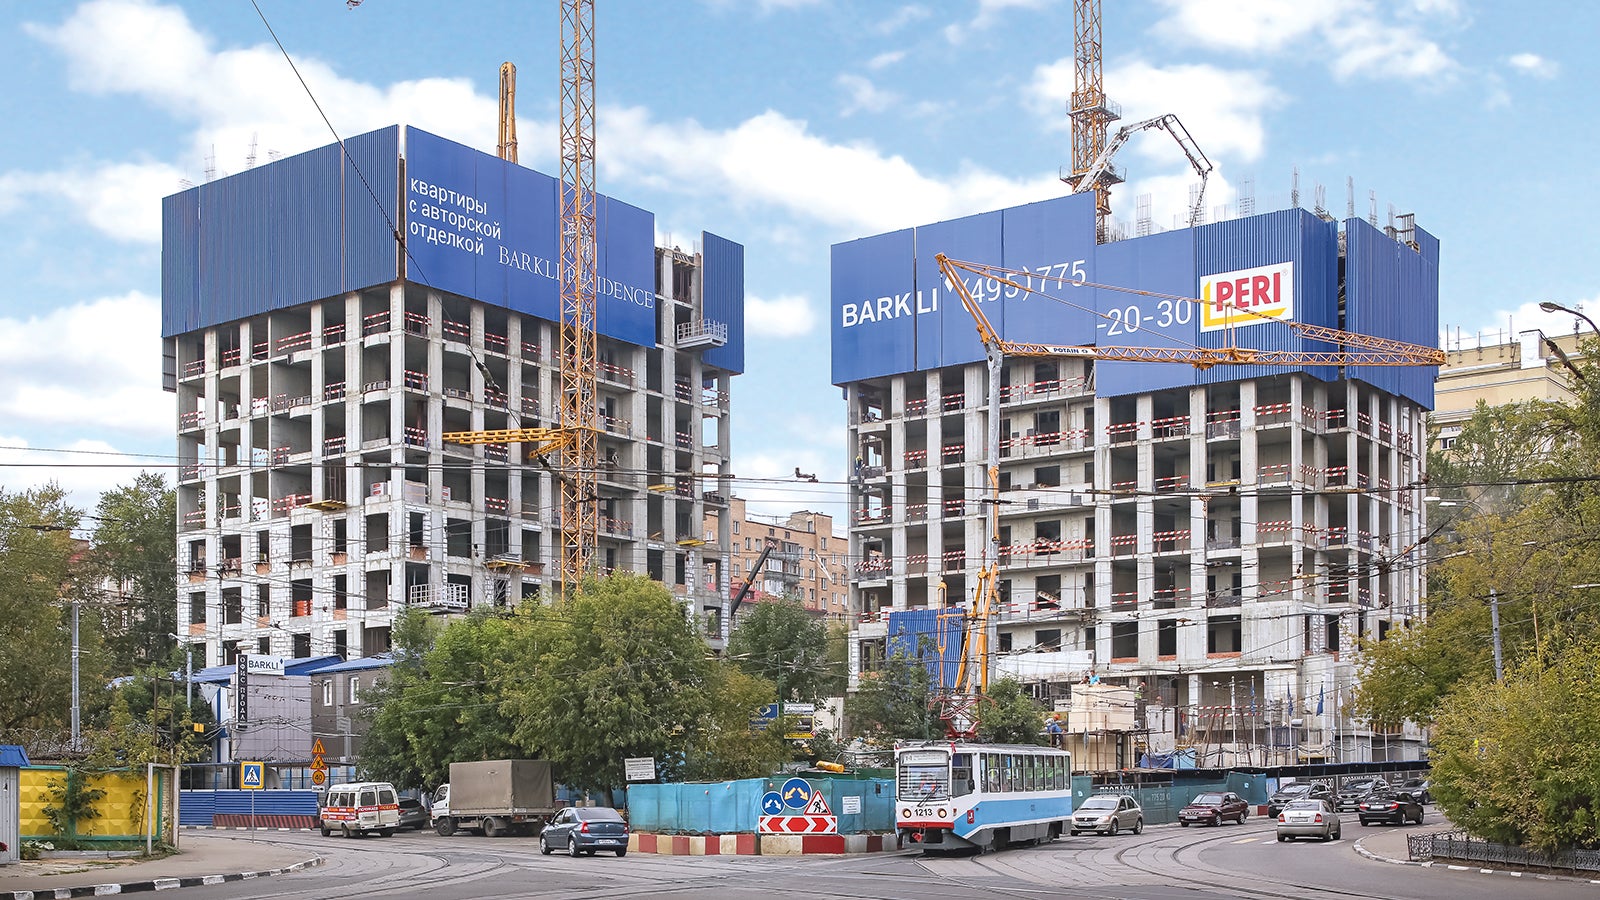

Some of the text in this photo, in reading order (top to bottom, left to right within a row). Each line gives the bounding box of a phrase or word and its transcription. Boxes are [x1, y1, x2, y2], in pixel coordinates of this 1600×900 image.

[410, 177, 487, 216] квартиры
[409, 199, 501, 241] с авторской
[410, 221, 484, 256] отделкой
[498, 244, 560, 281] BARKLI
[842, 287, 938, 328] BARKLI
[1216, 272, 1281, 312] PERI
[248, 660, 279, 670] BARKLI
[914, 808, 933, 817] 1213
